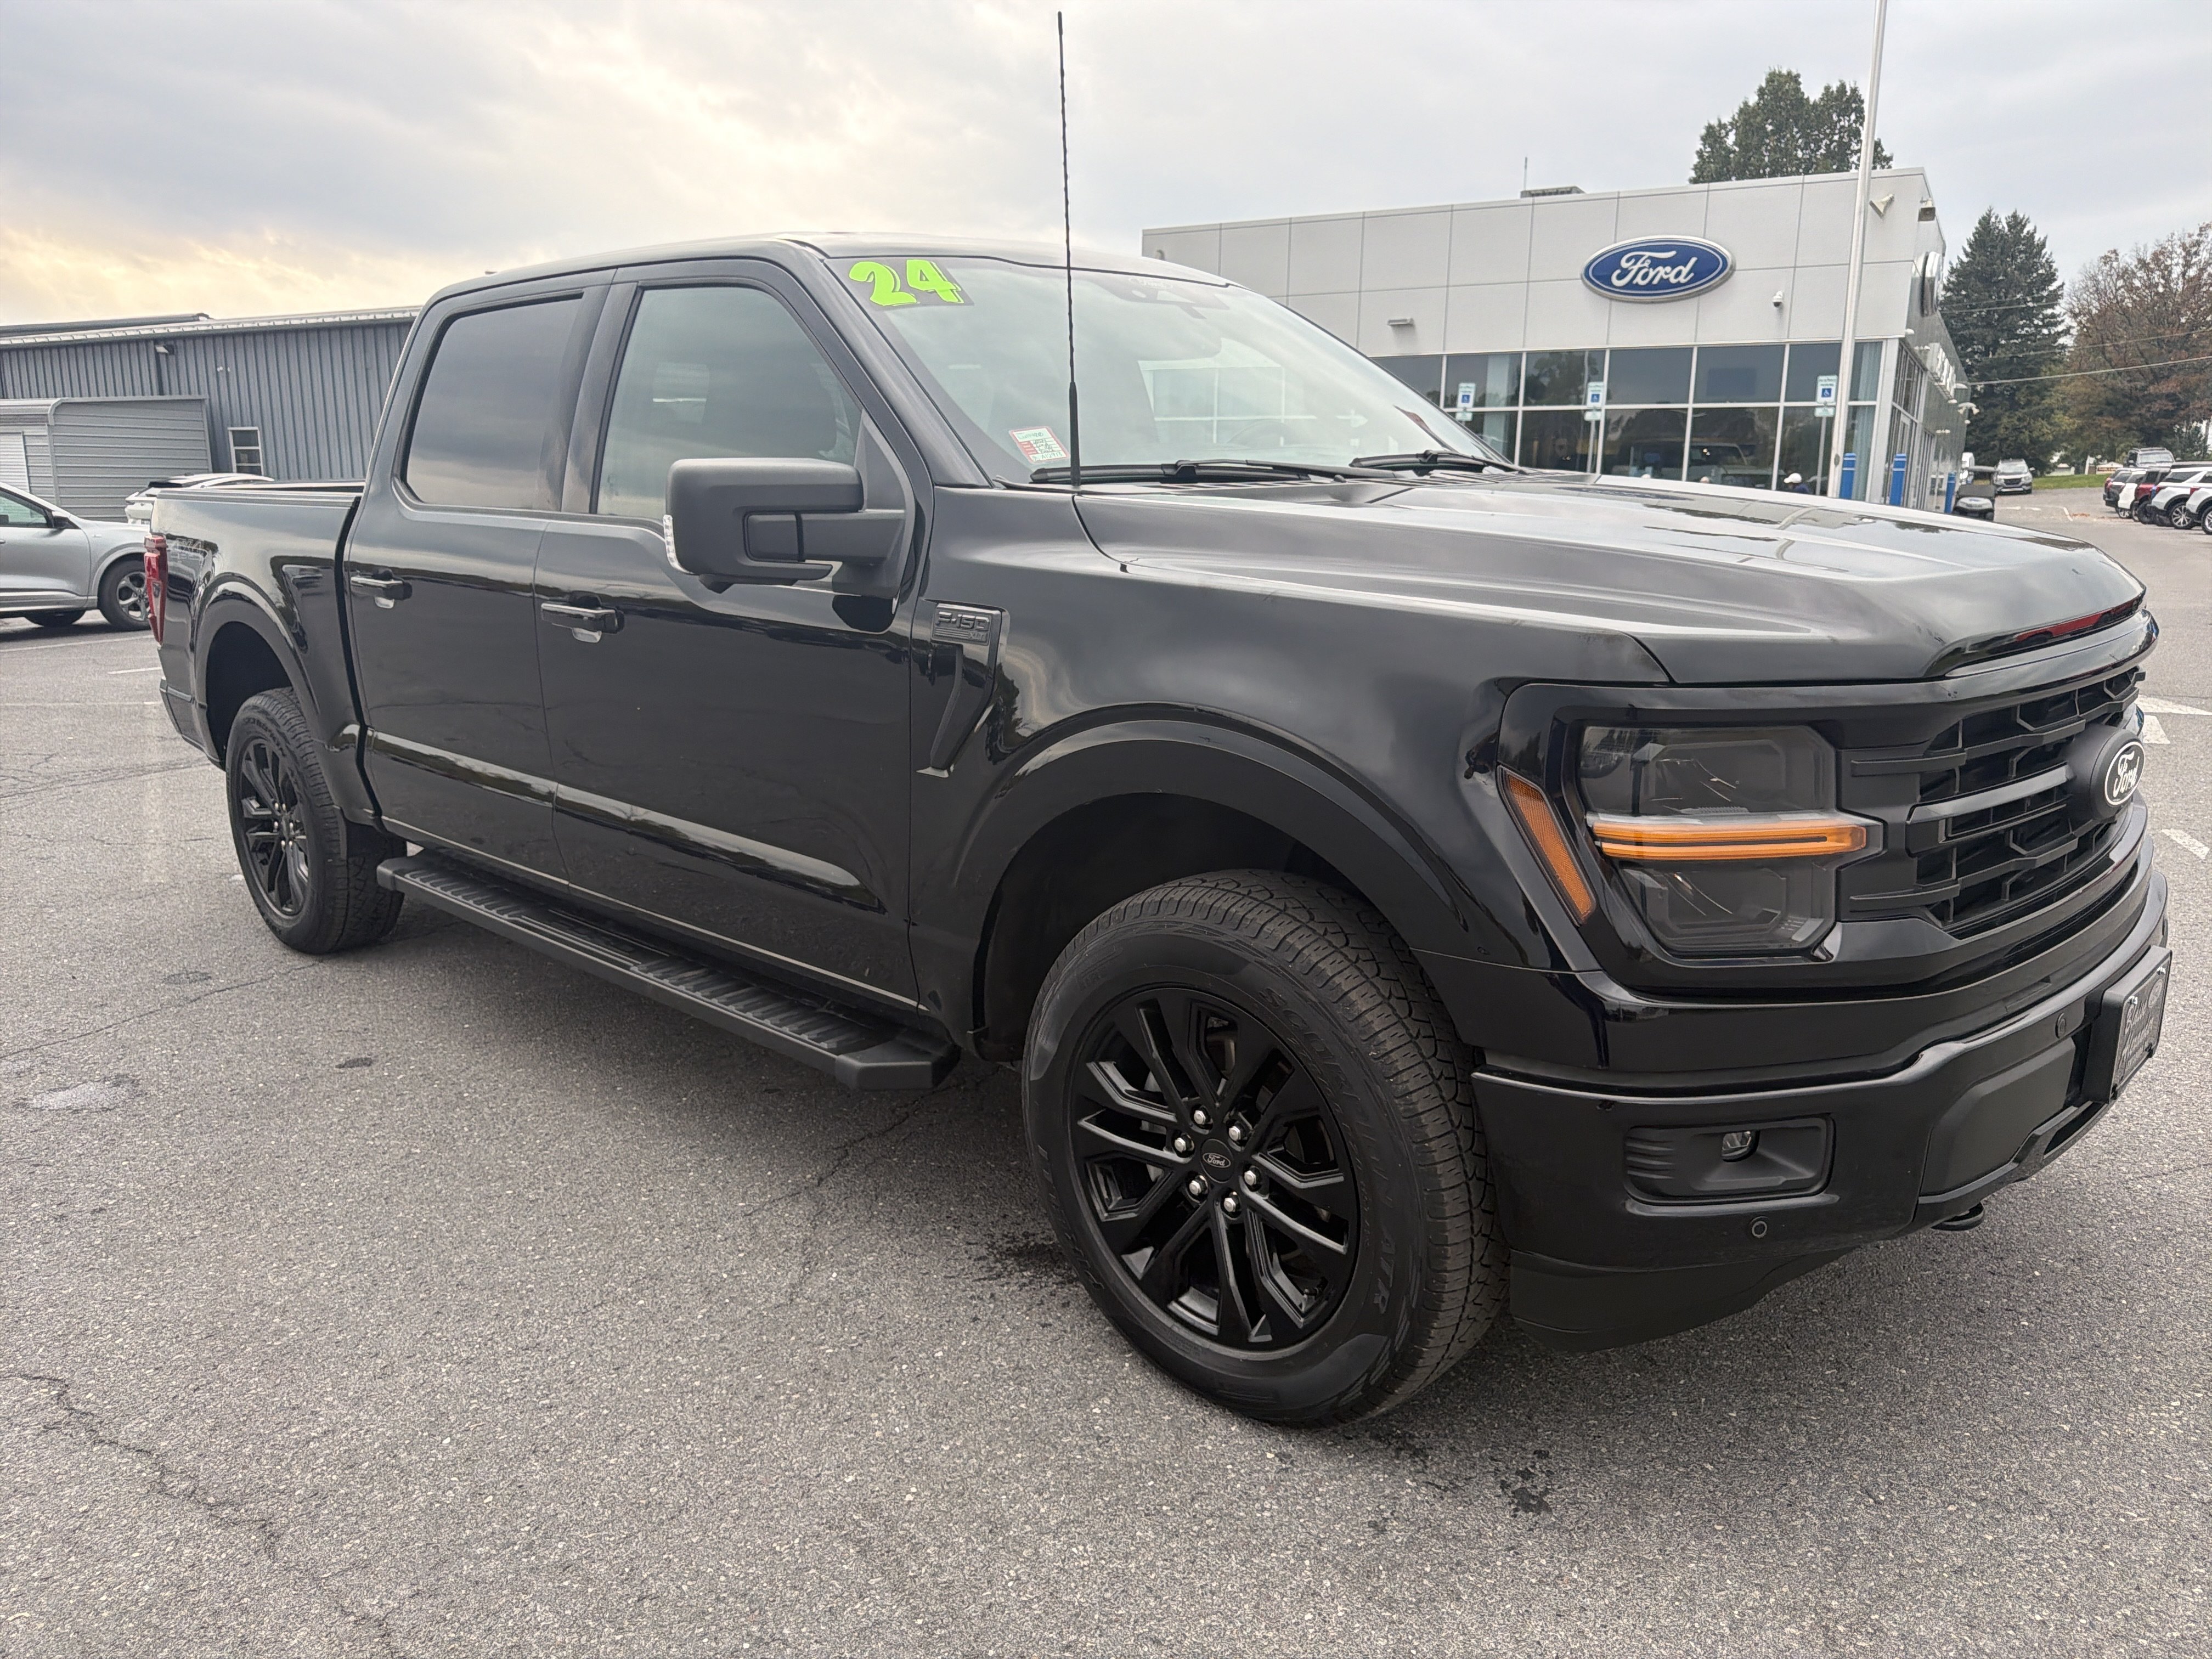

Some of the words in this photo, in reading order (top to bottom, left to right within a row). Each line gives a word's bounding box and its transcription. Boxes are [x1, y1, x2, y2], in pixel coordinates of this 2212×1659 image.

[849, 259, 964, 306] 24
[1611, 250, 1698, 287] Ford
[969, 632, 985, 640] XLT
[2113, 751, 2140, 798] Ford
[1207, 1154, 1226, 1166] Ford
